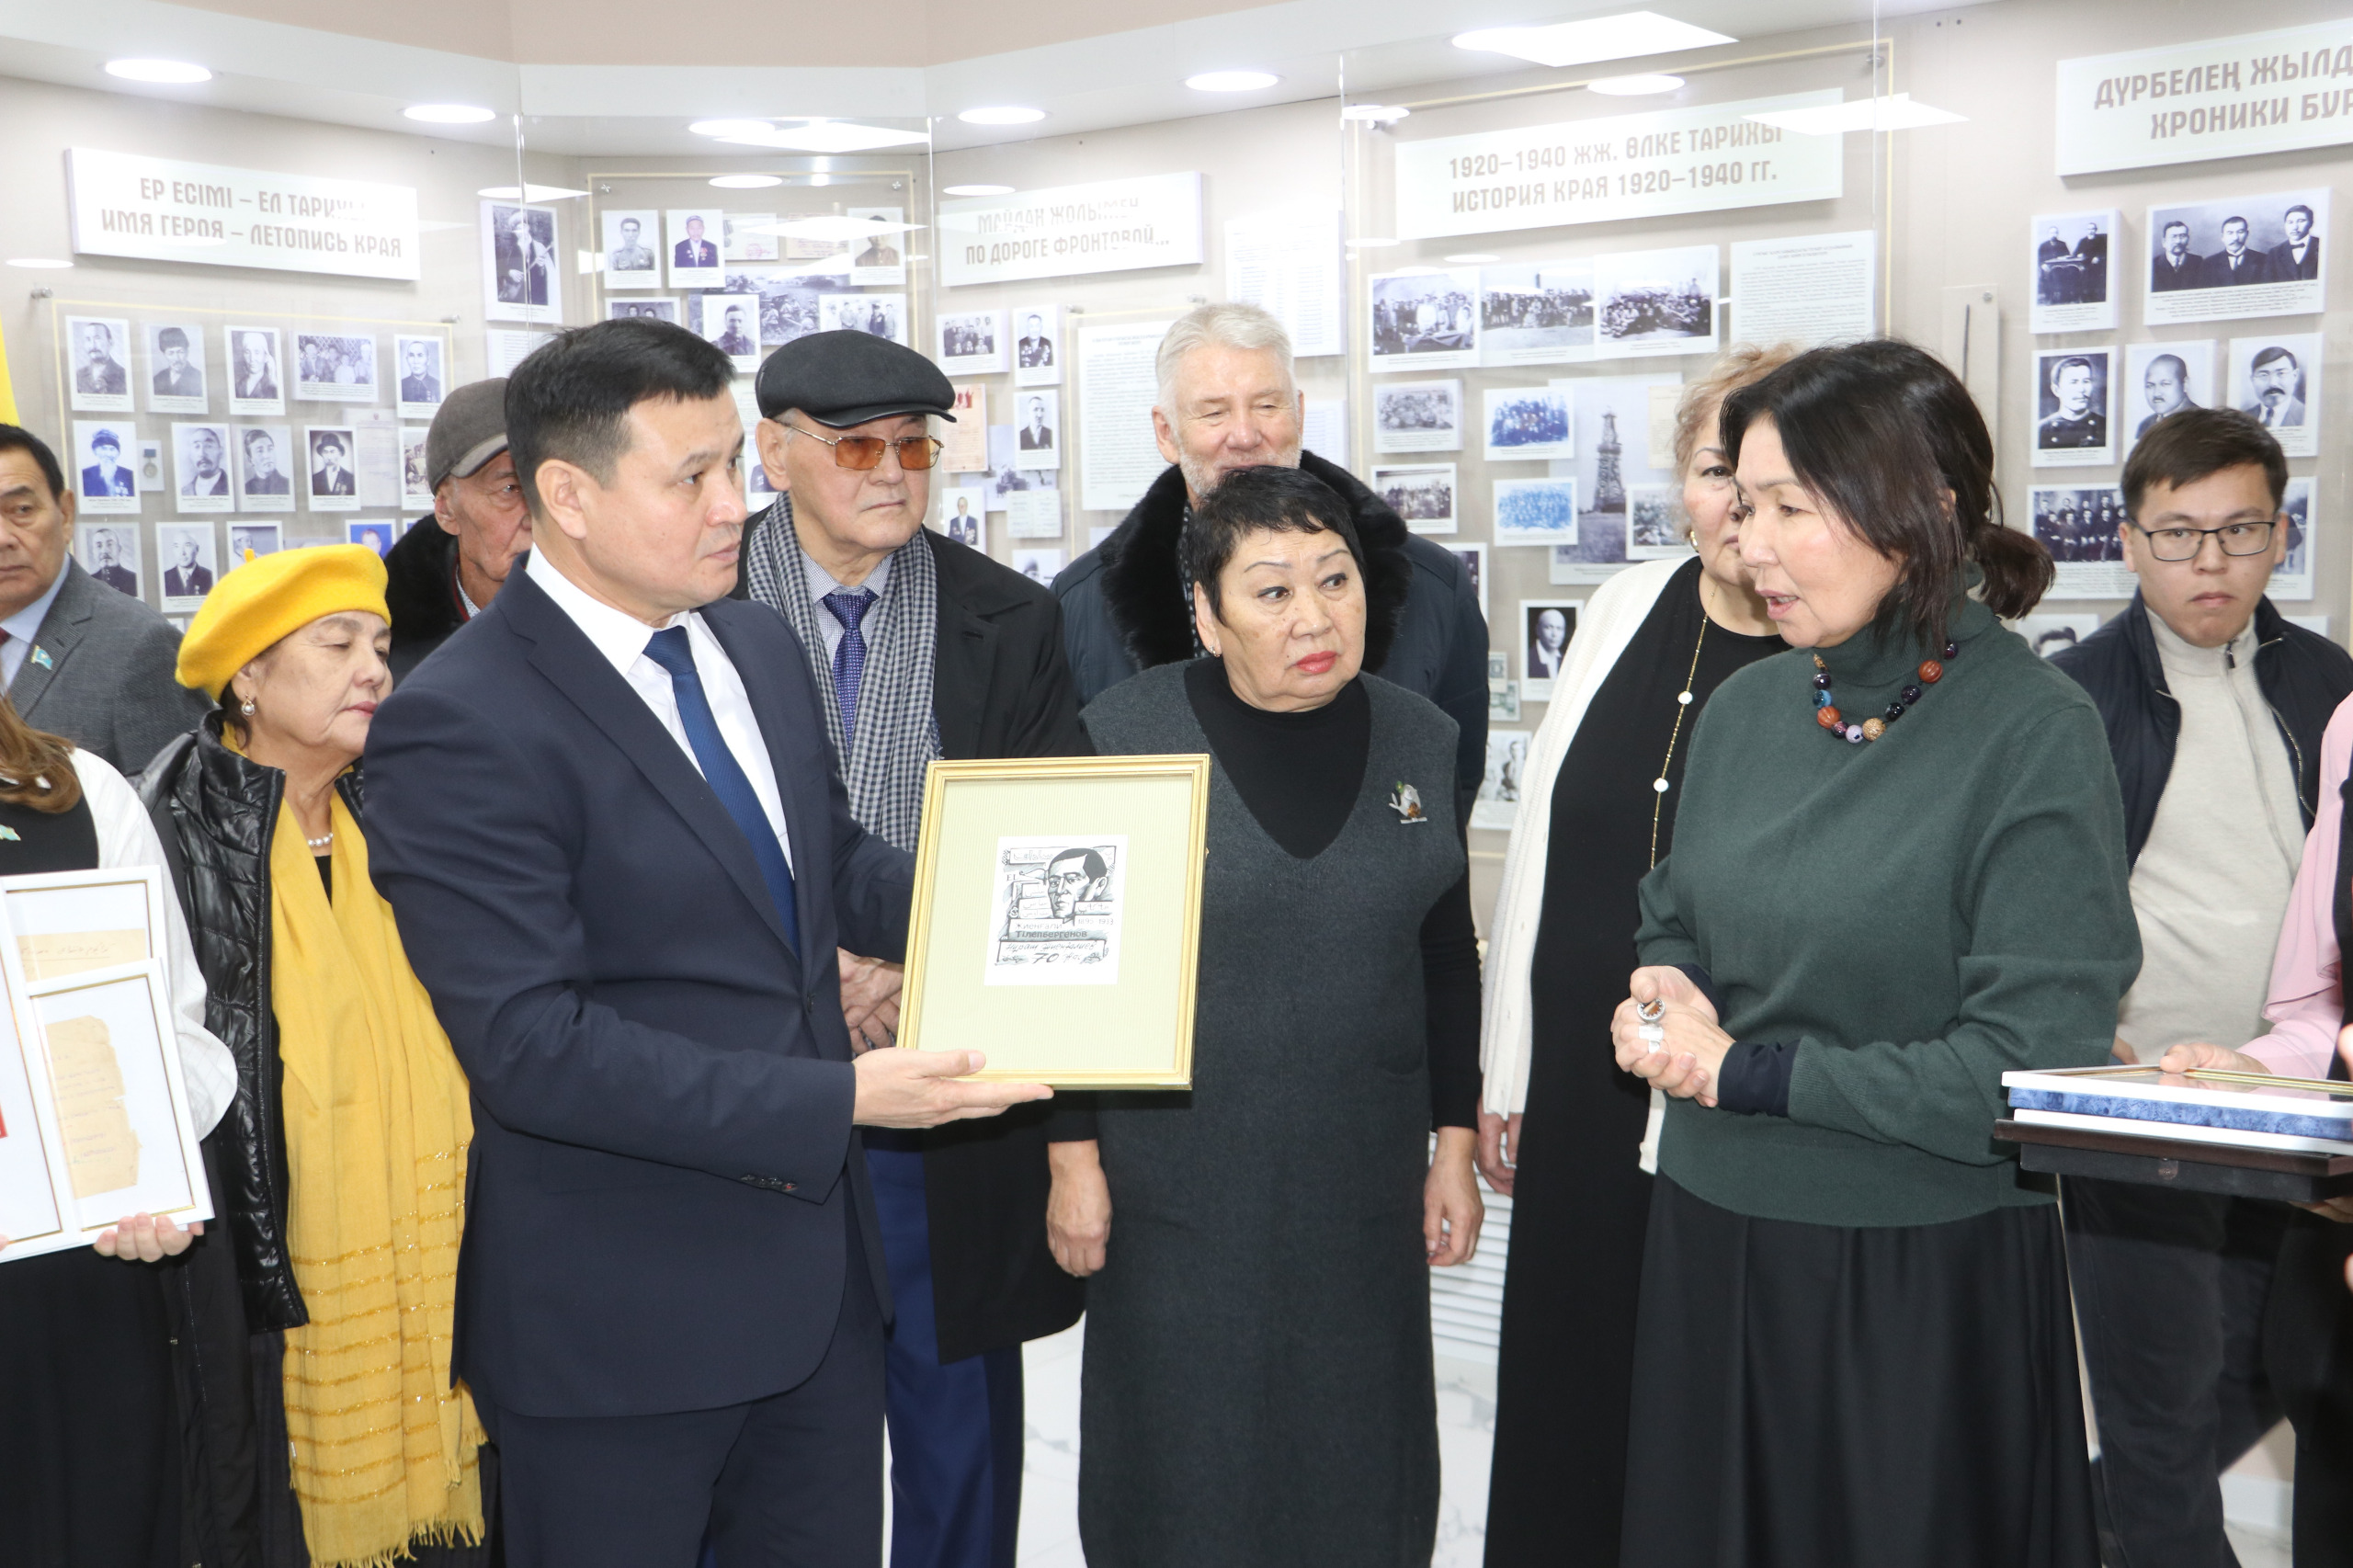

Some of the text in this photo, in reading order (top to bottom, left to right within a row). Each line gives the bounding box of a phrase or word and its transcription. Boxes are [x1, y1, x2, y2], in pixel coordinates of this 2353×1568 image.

[2094, 61, 2241, 109] ДҮРБЕЛЕҢ
[2150, 97, 2290, 140] ХРОНИКИ
[1574, 142, 1619, 165] ЖЖ.
[1625, 131, 1681, 159] ӨЛКЕ
[1688, 121, 1782, 153] ТАРИХЫ
[140, 177, 165, 201] ЕР
[173, 181, 233, 209] ЕСІМІ
[258, 190, 282, 214] ЕЛ
[1452, 183, 1546, 213] ИСТОРИЯ
[1553, 176, 1609, 202] КРАЯ
[1751, 160, 1778, 183] ГГ.
[101, 209, 154, 236] ИМЯ
[161, 214, 224, 239] ГЕРОЯ
[251, 223, 348, 253] ЛЕТОПИСЬ
[355, 233, 402, 258] КРАЯ
[966, 244, 986, 265] ПО
[990, 238, 1049, 266] ДОРОГЕ
[1032, 952, 1060, 964] 70
